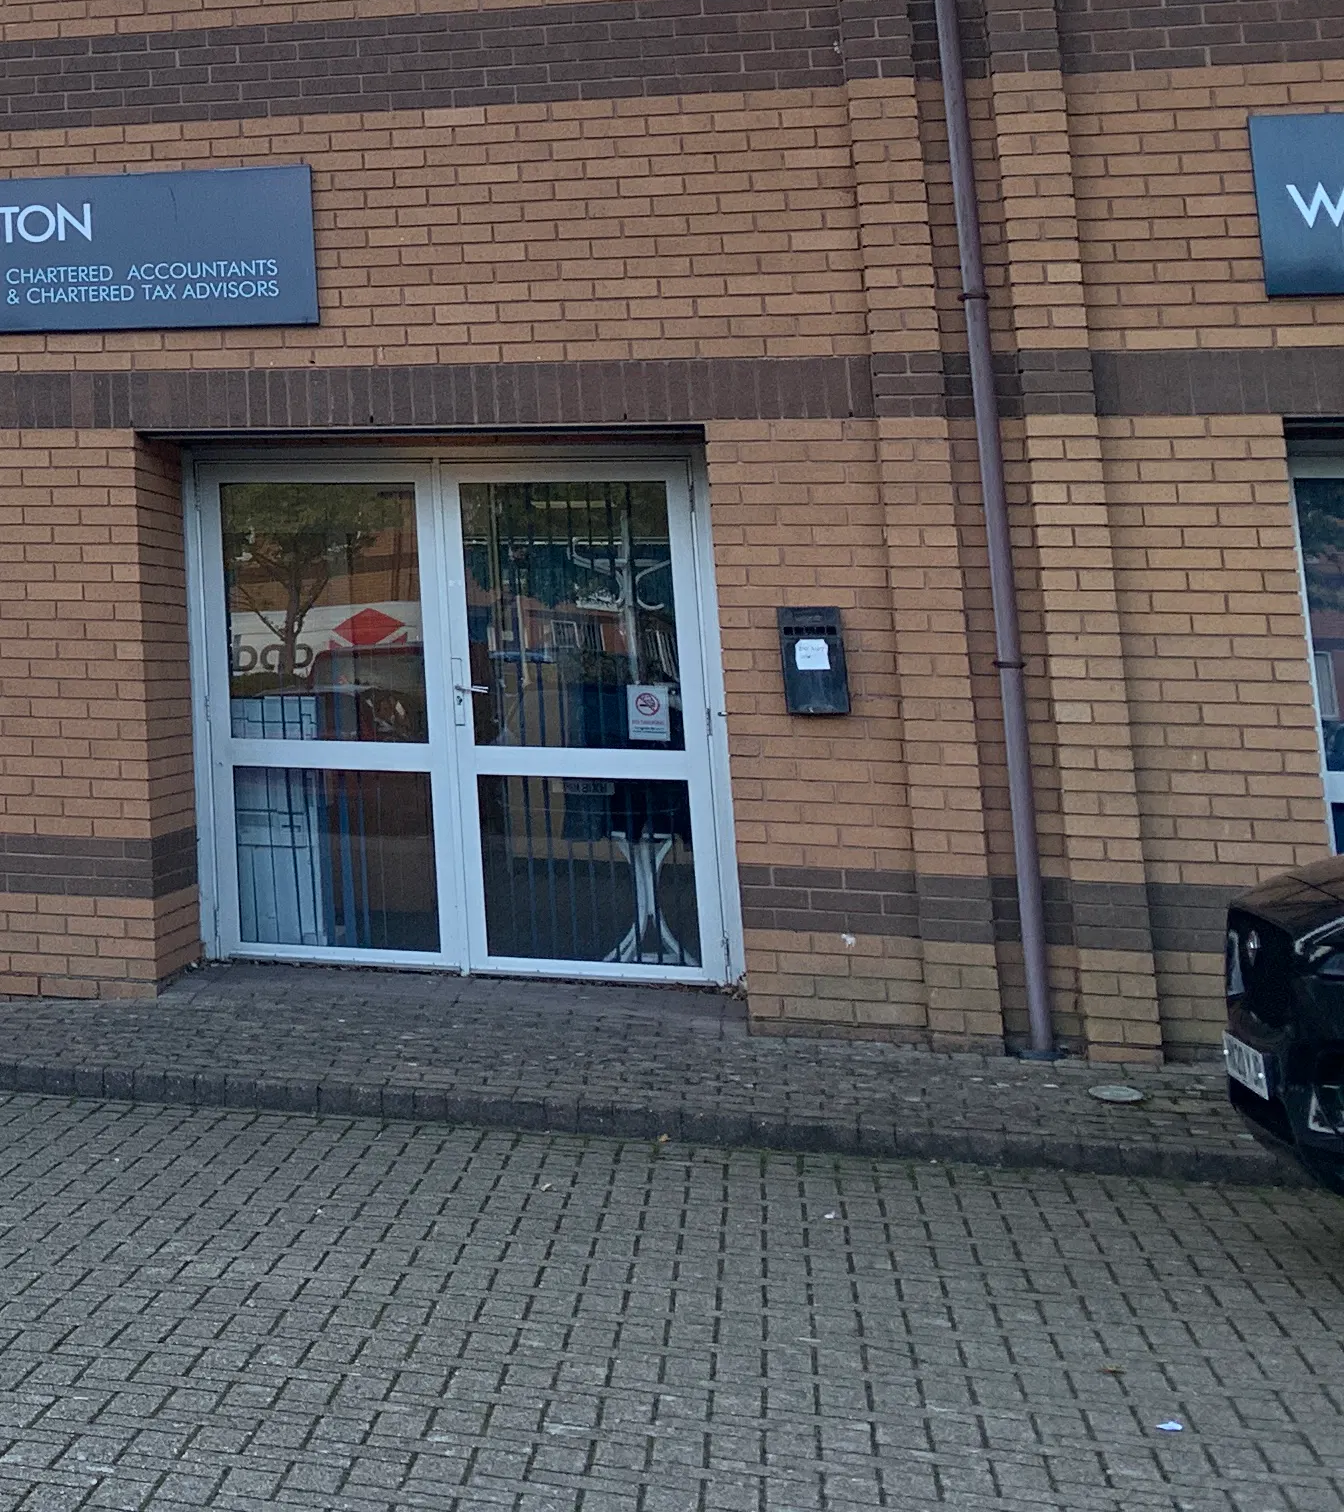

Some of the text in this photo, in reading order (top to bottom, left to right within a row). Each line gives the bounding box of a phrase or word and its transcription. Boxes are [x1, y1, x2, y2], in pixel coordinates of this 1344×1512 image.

[6, 259, 279, 285] CHARTERED ACCOUNTANTS
[6, 280, 280, 305] & CHARTERED TAX ADVISORS
